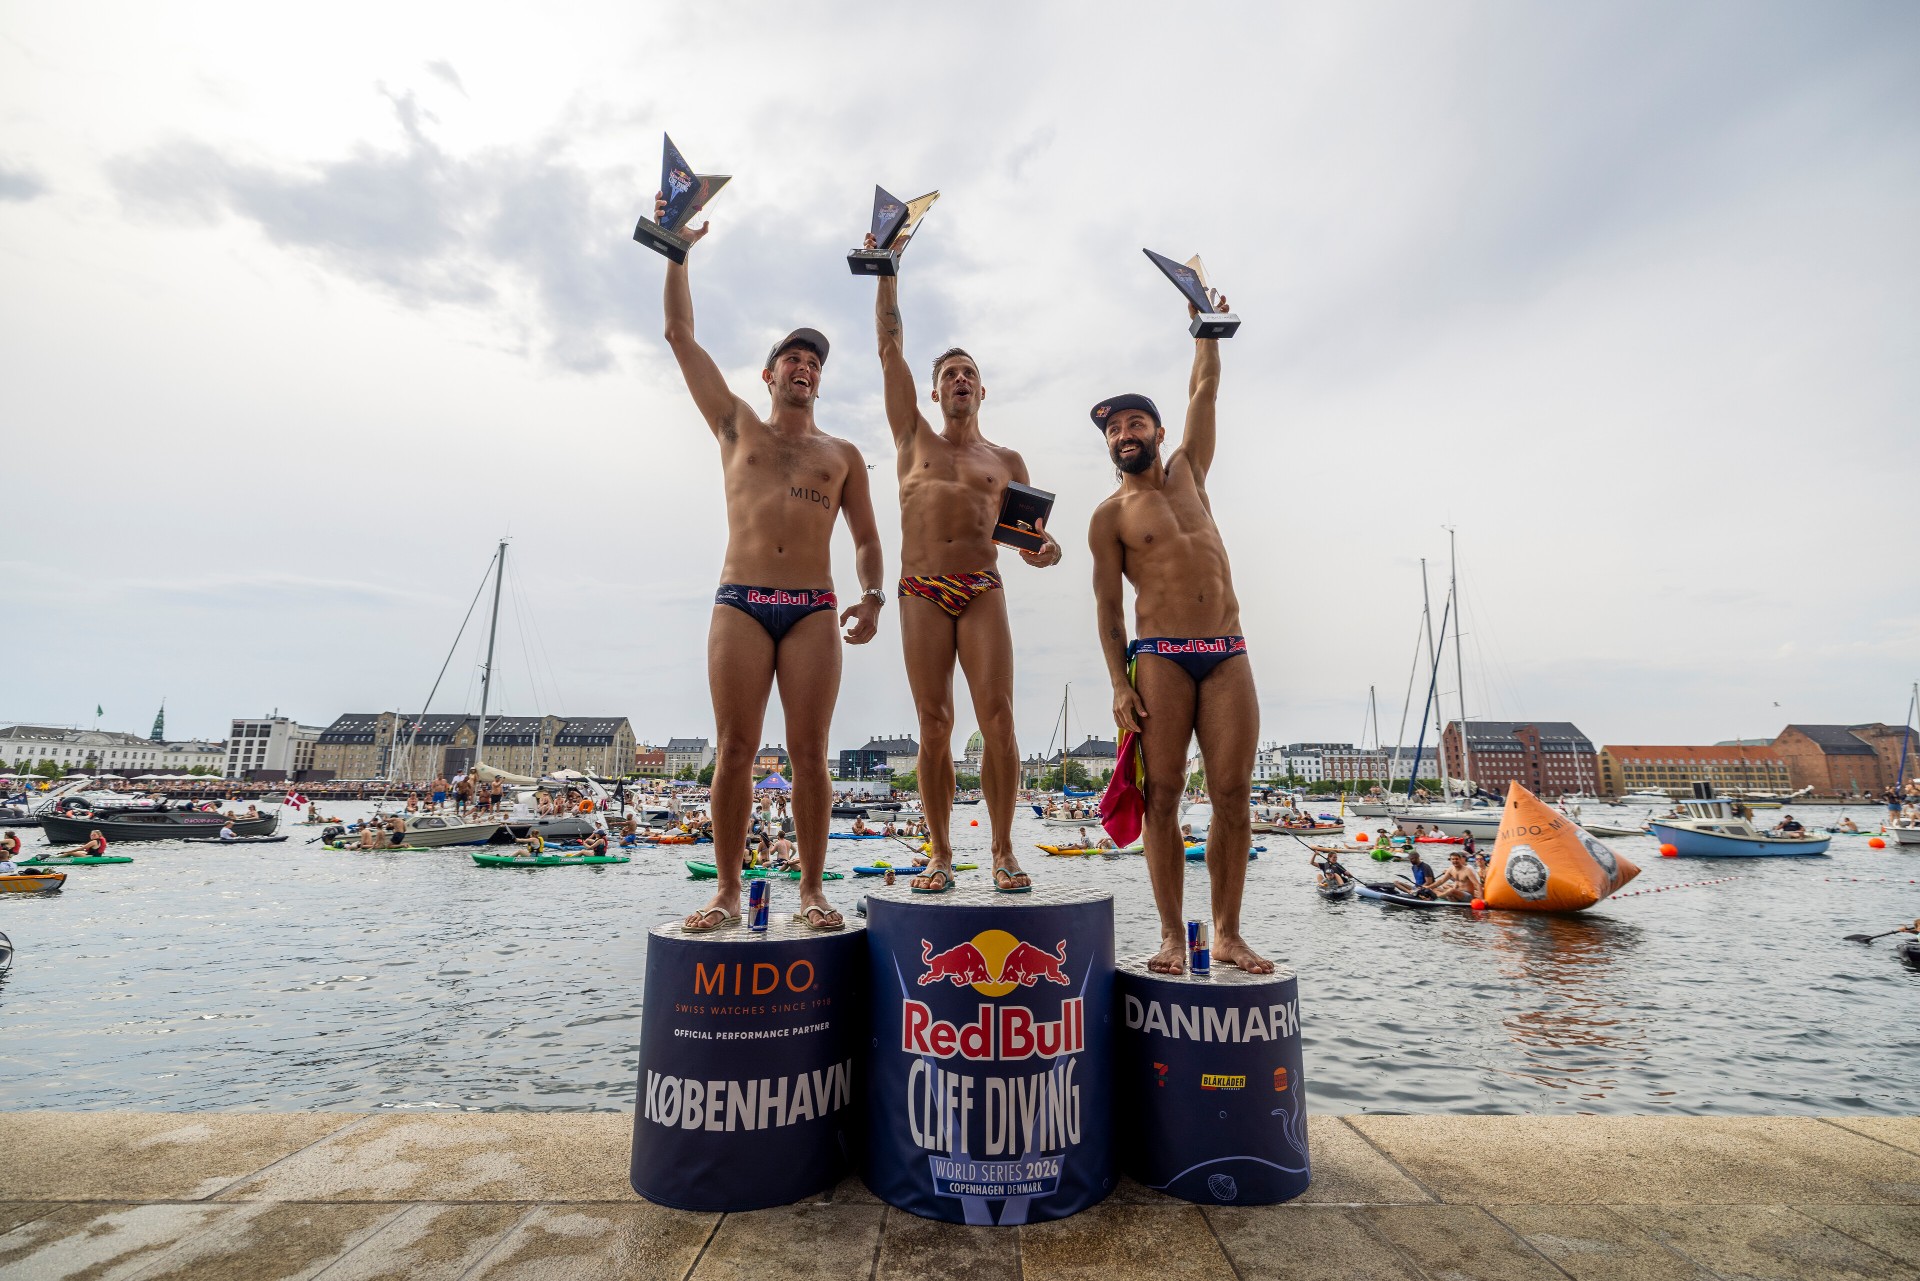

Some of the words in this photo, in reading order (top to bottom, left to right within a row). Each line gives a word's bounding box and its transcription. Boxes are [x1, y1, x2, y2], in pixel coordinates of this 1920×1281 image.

[790, 486, 831, 509] MIDO
[747, 589, 779, 605] Red
[779, 590, 809, 606] Bull
[1157, 639, 1195, 654] Red
[1195, 638, 1227, 653] Bull
[1501, 825, 1542, 840] MIDO
[694, 959, 816, 996] MIDO
[675, 1003, 705, 1014] SWISS
[710, 1005, 765, 1015] WATCHES
[771, 1002, 806, 1014] SINCE
[812, 997, 832, 1009] 1918
[901, 998, 995, 1061] Red
[998, 997, 1085, 1061] Bull
[1125, 993, 1300, 1043] DANMARK
[674, 1028, 713, 1040] OFFICIAL
[716, 1028, 789, 1040] PERFORMANCE
[792, 1021, 830, 1036] PARTNER
[644, 1058, 852, 1132] KØBENHAVN
[907, 1058, 974, 1154] CLIFF
[985, 1056, 1081, 1155] DIVING
[935, 1159, 976, 1181] WORLD
[981, 1164, 1022, 1182] SERIES
[1026, 1159, 1059, 1180] 2026
[949, 1182, 1004, 1195] COPENHAGEN
[1007, 1181, 1043, 1195] DENMARK
